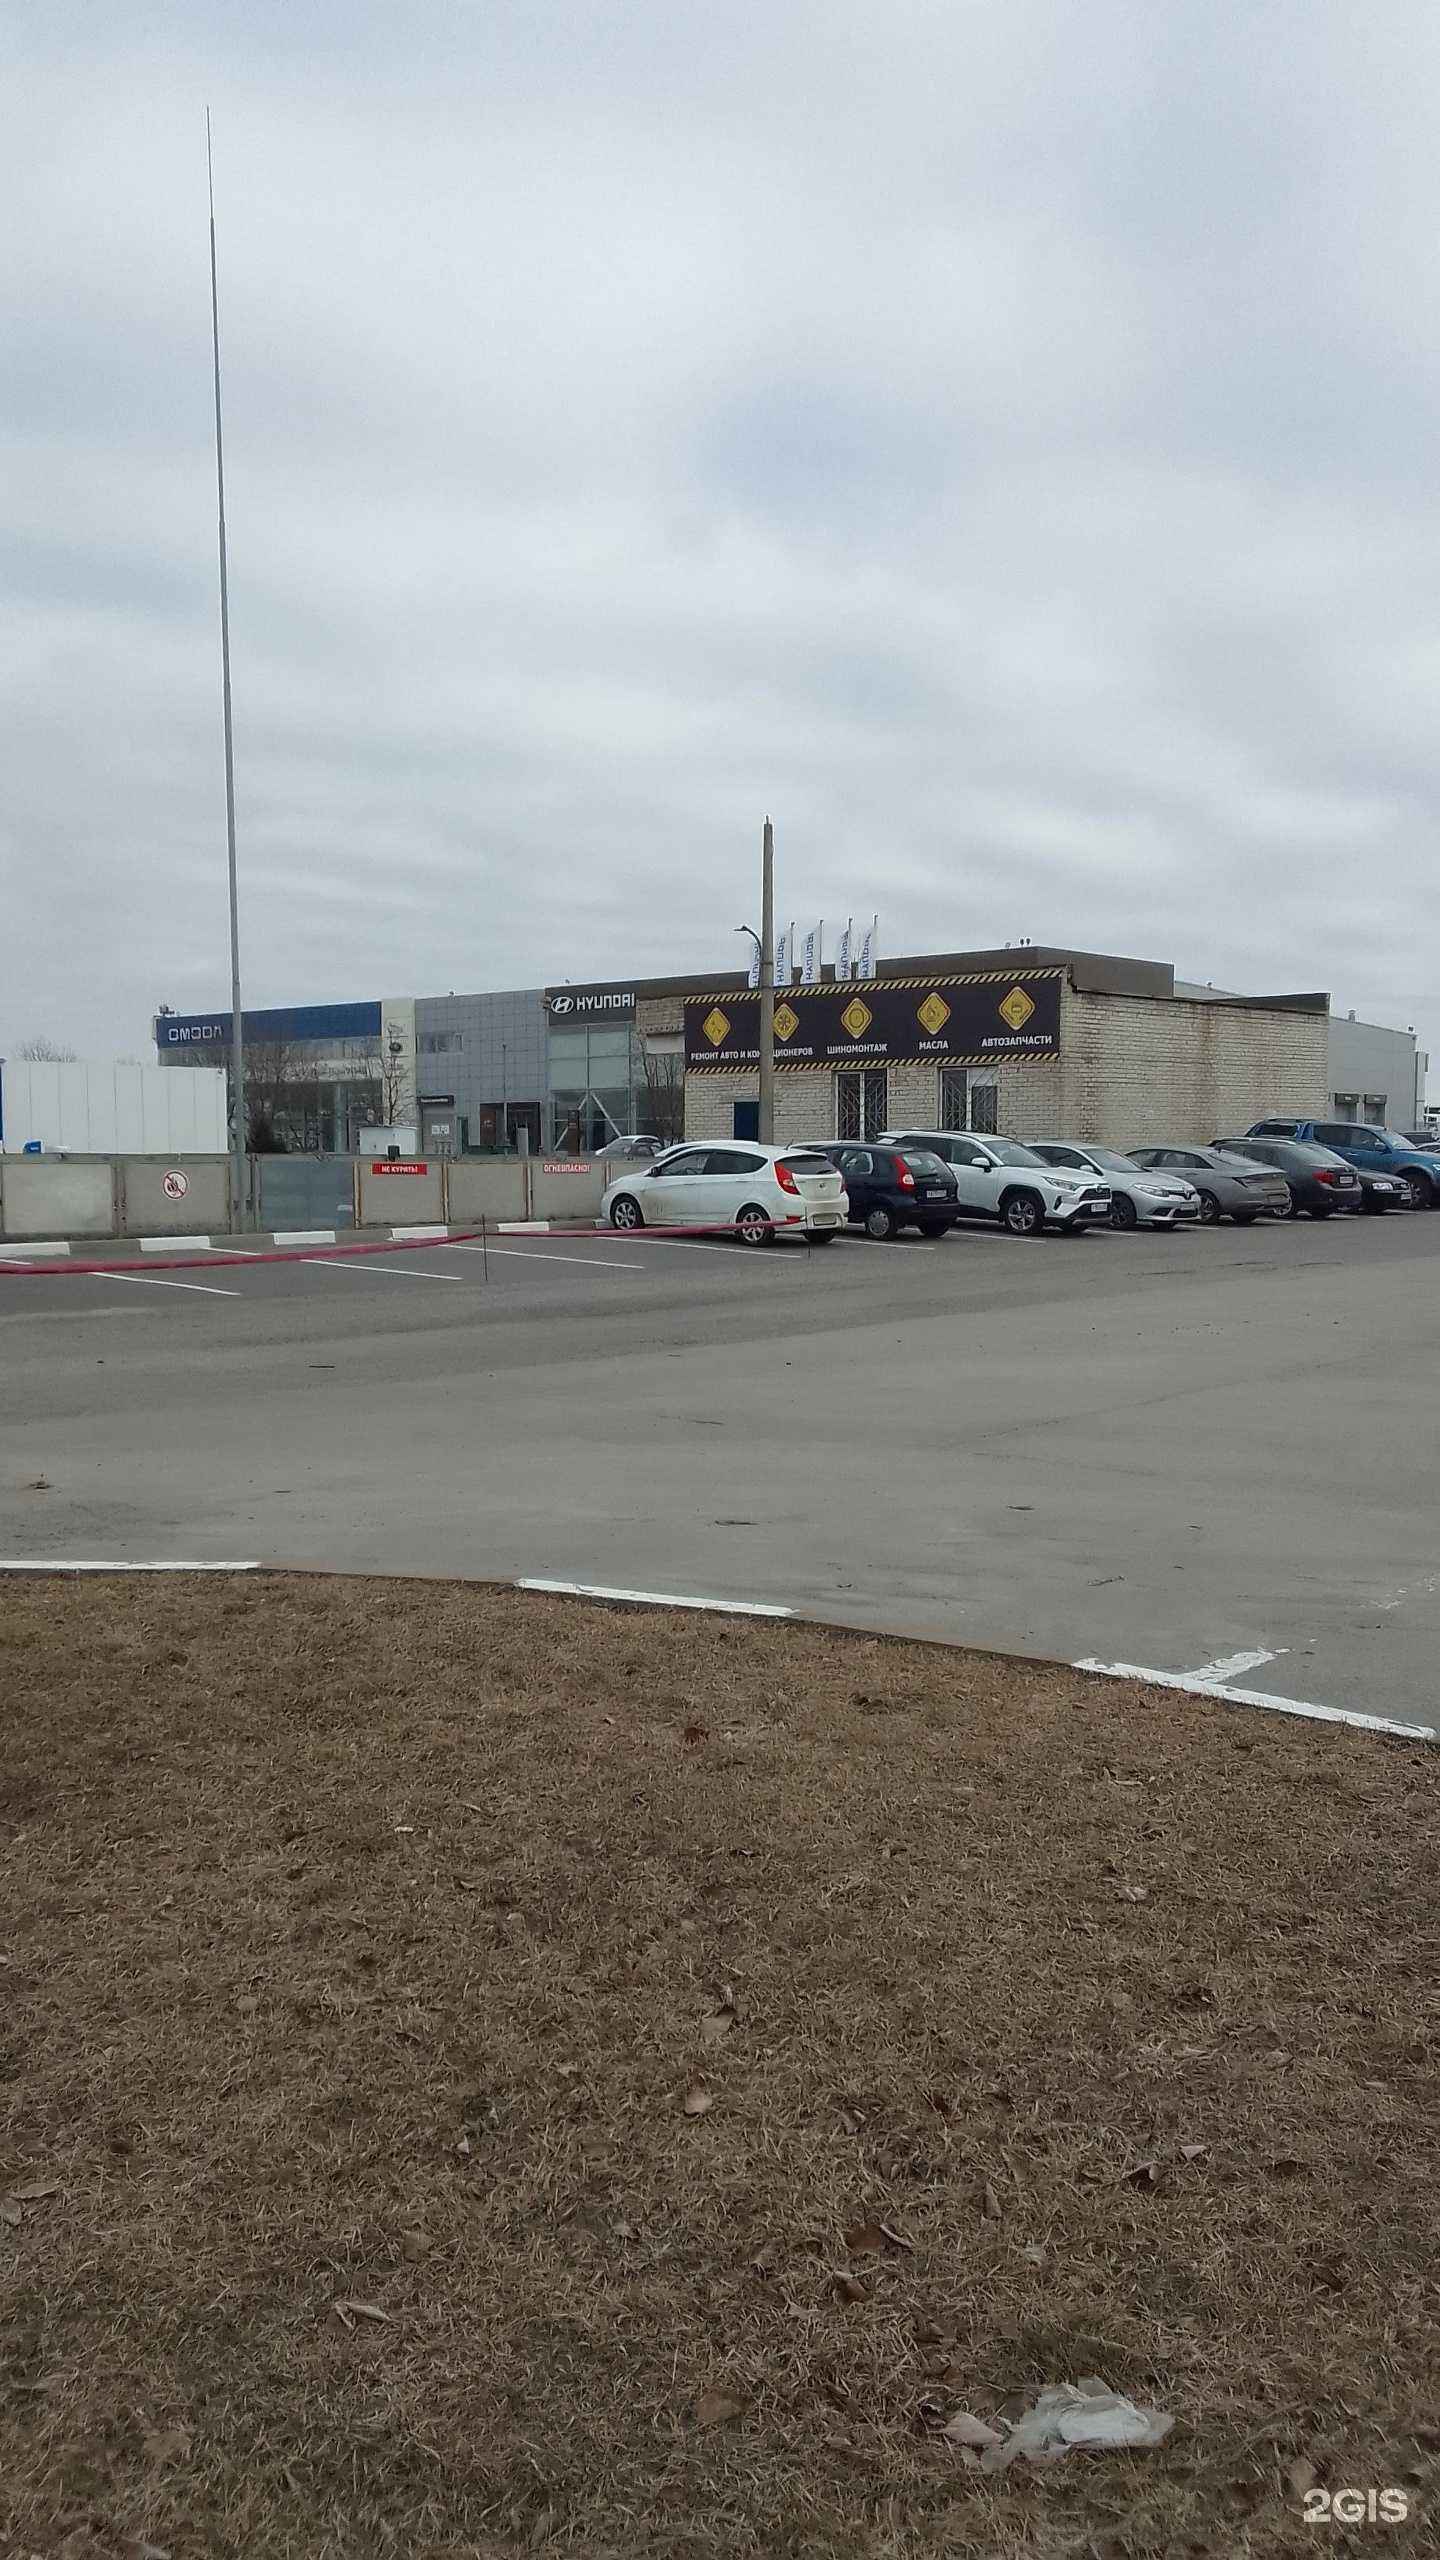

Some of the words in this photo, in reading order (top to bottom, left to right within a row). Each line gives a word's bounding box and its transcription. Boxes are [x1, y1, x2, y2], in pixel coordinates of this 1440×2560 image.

[576, 992, 635, 1011] HYUNDAI
[918, 1040, 949, 1051] МАСЛА
[981, 1035, 1053, 1048] АВТОЗАПЧАСТИ
[826, 1043, 888, 1055] ШИНОМОНТАЖ
[690, 1051, 719, 1061] РЕМОНТ
[720, 1051, 739, 1059] АВТО
[740, 1050, 746, 1058] И
